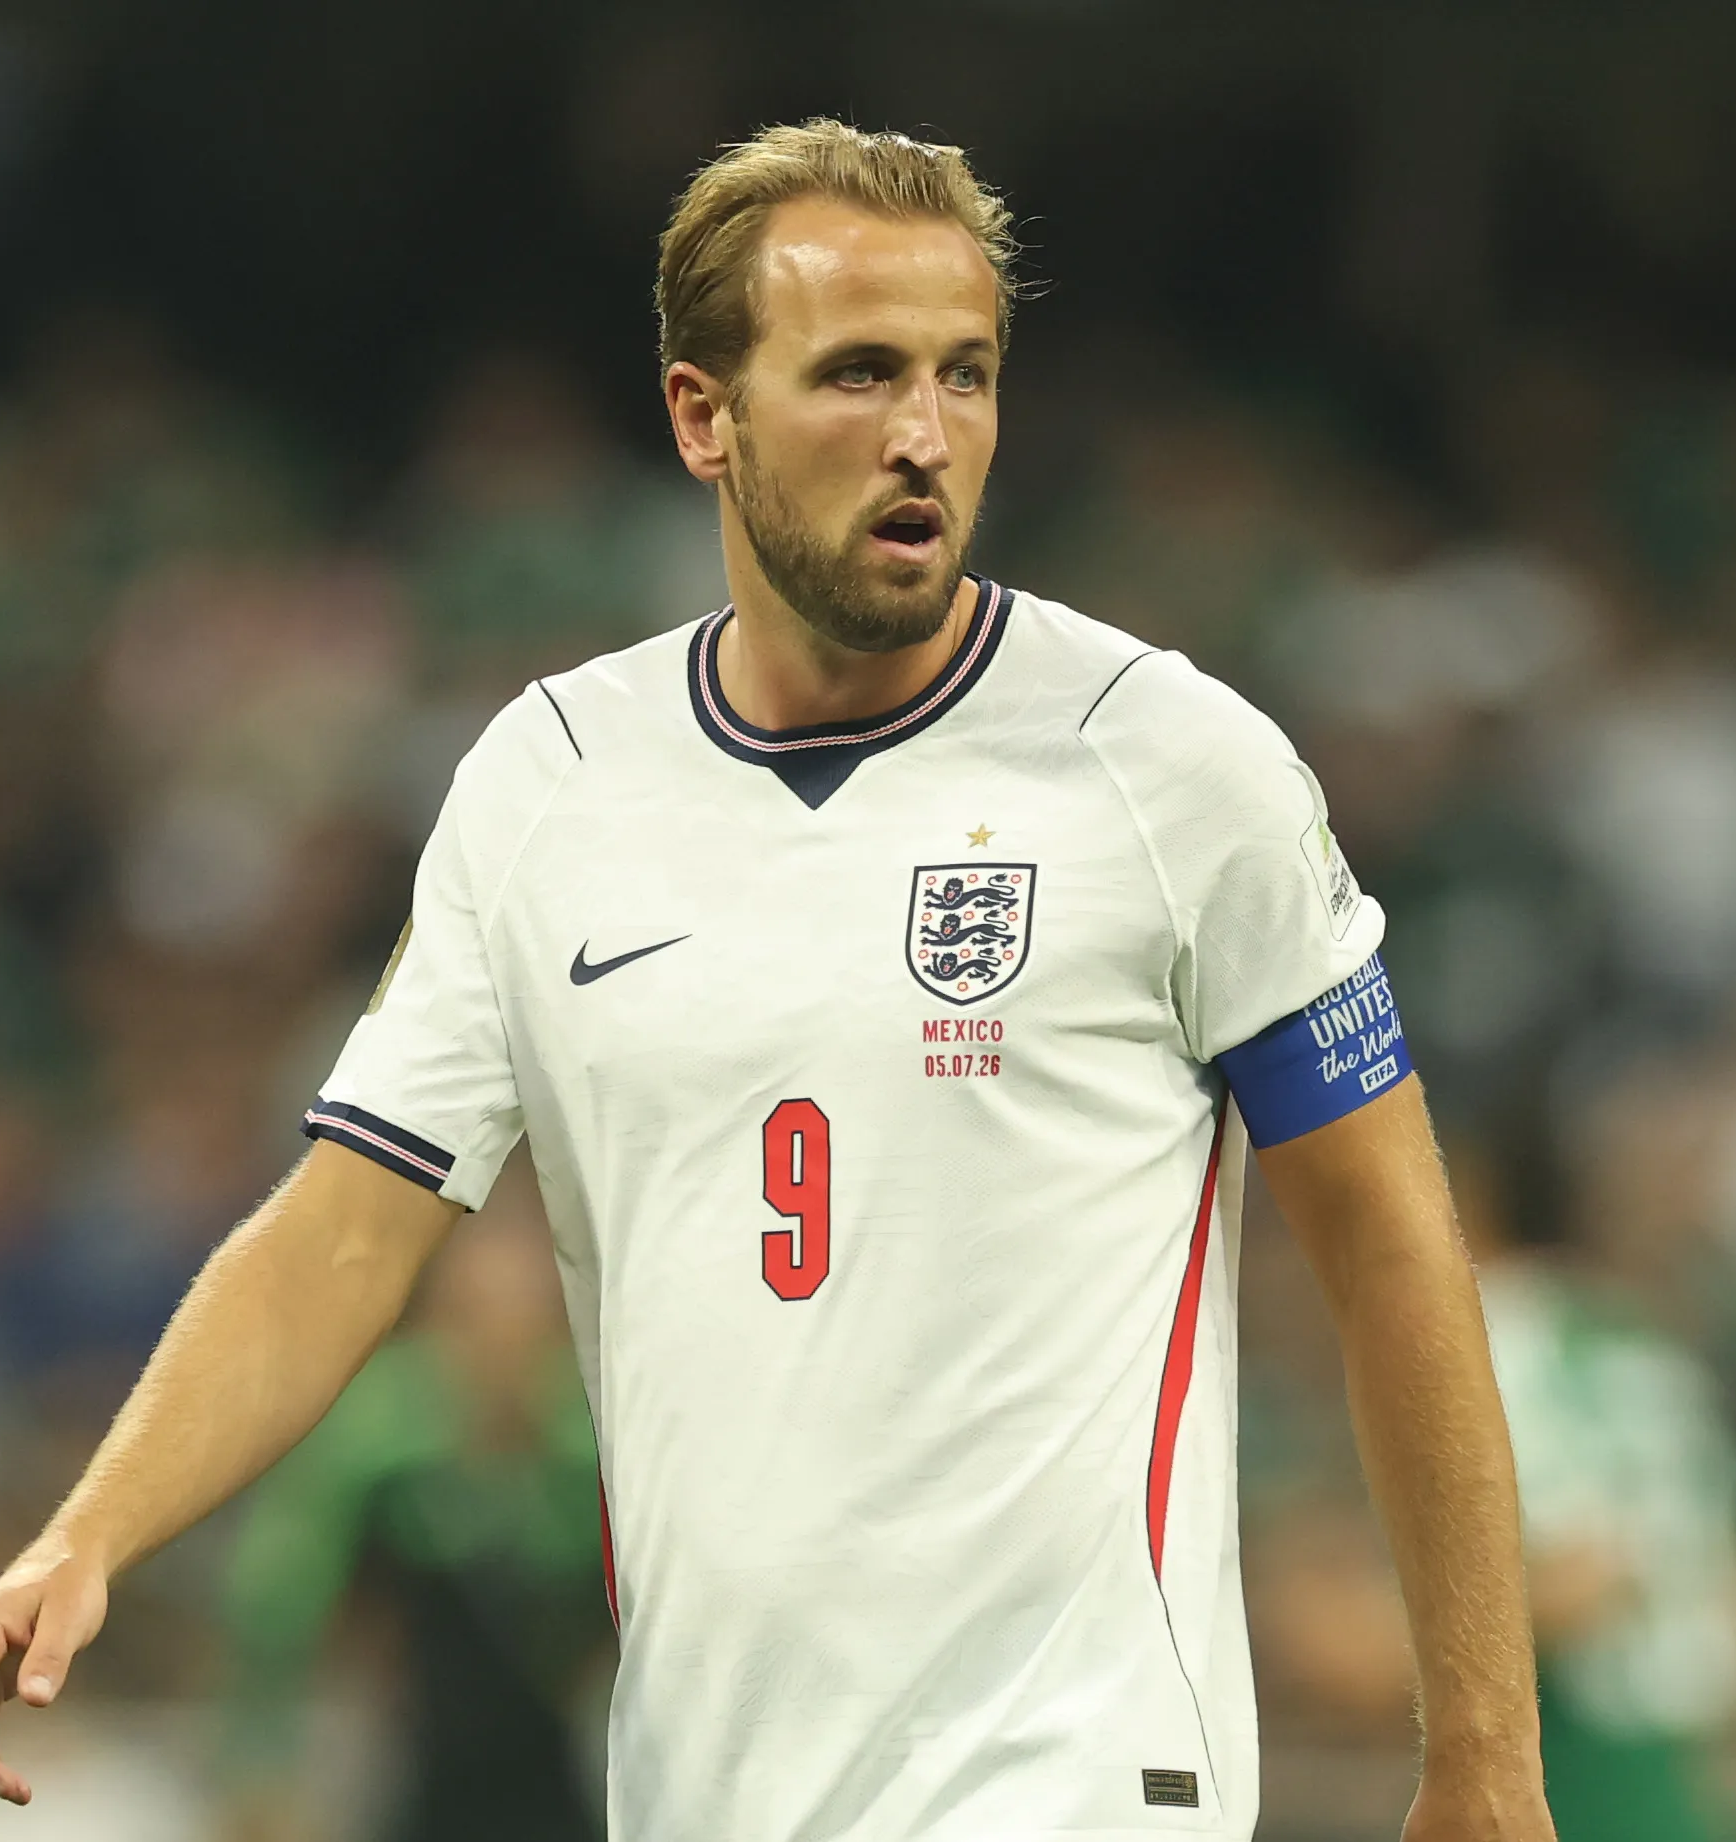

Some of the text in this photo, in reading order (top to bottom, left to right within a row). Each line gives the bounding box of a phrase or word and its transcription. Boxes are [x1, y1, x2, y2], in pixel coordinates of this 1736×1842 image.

[922, 1019, 1004, 1043] MEXICO
[1308, 975, 1394, 1049] UNITES
[924, 1054, 1001, 1078] 05.07.26
[1316, 1009, 1404, 1084] the World
[1365, 1061, 1396, 1088] FIFA
[761, 1097, 830, 1302] 9
